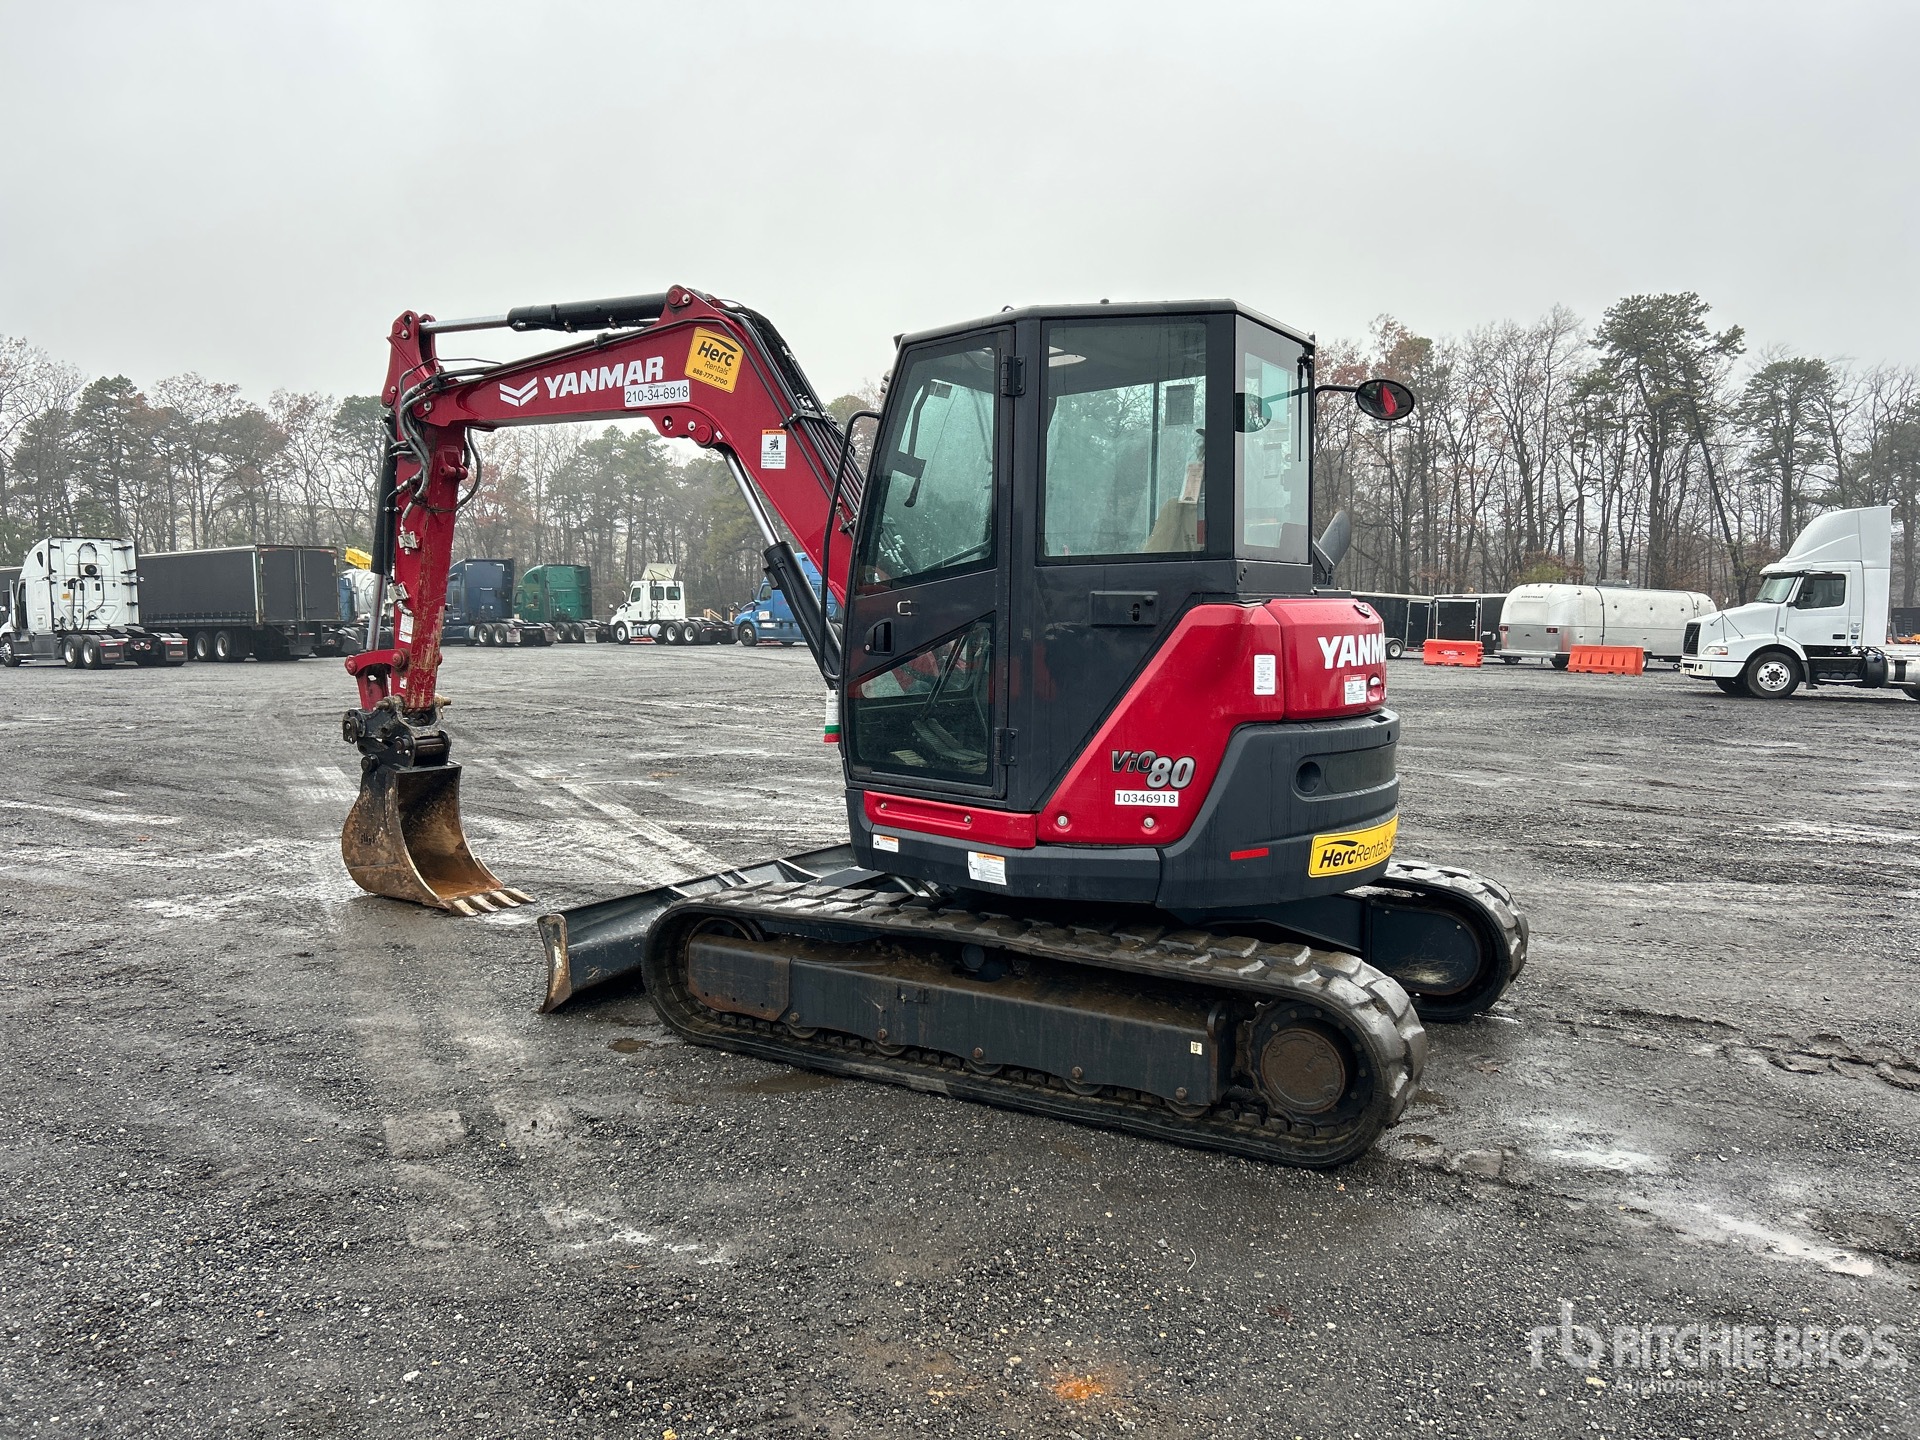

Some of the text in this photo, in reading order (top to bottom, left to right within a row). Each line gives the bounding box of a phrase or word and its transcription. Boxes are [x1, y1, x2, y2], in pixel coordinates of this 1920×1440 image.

[697, 341, 734, 367] Herc
[544, 356, 664, 399] YANMAR
[704, 361, 729, 376] Rentals
[625, 385, 689, 403] 210-34-6918
[1116, 793, 1176, 804] 10346918
